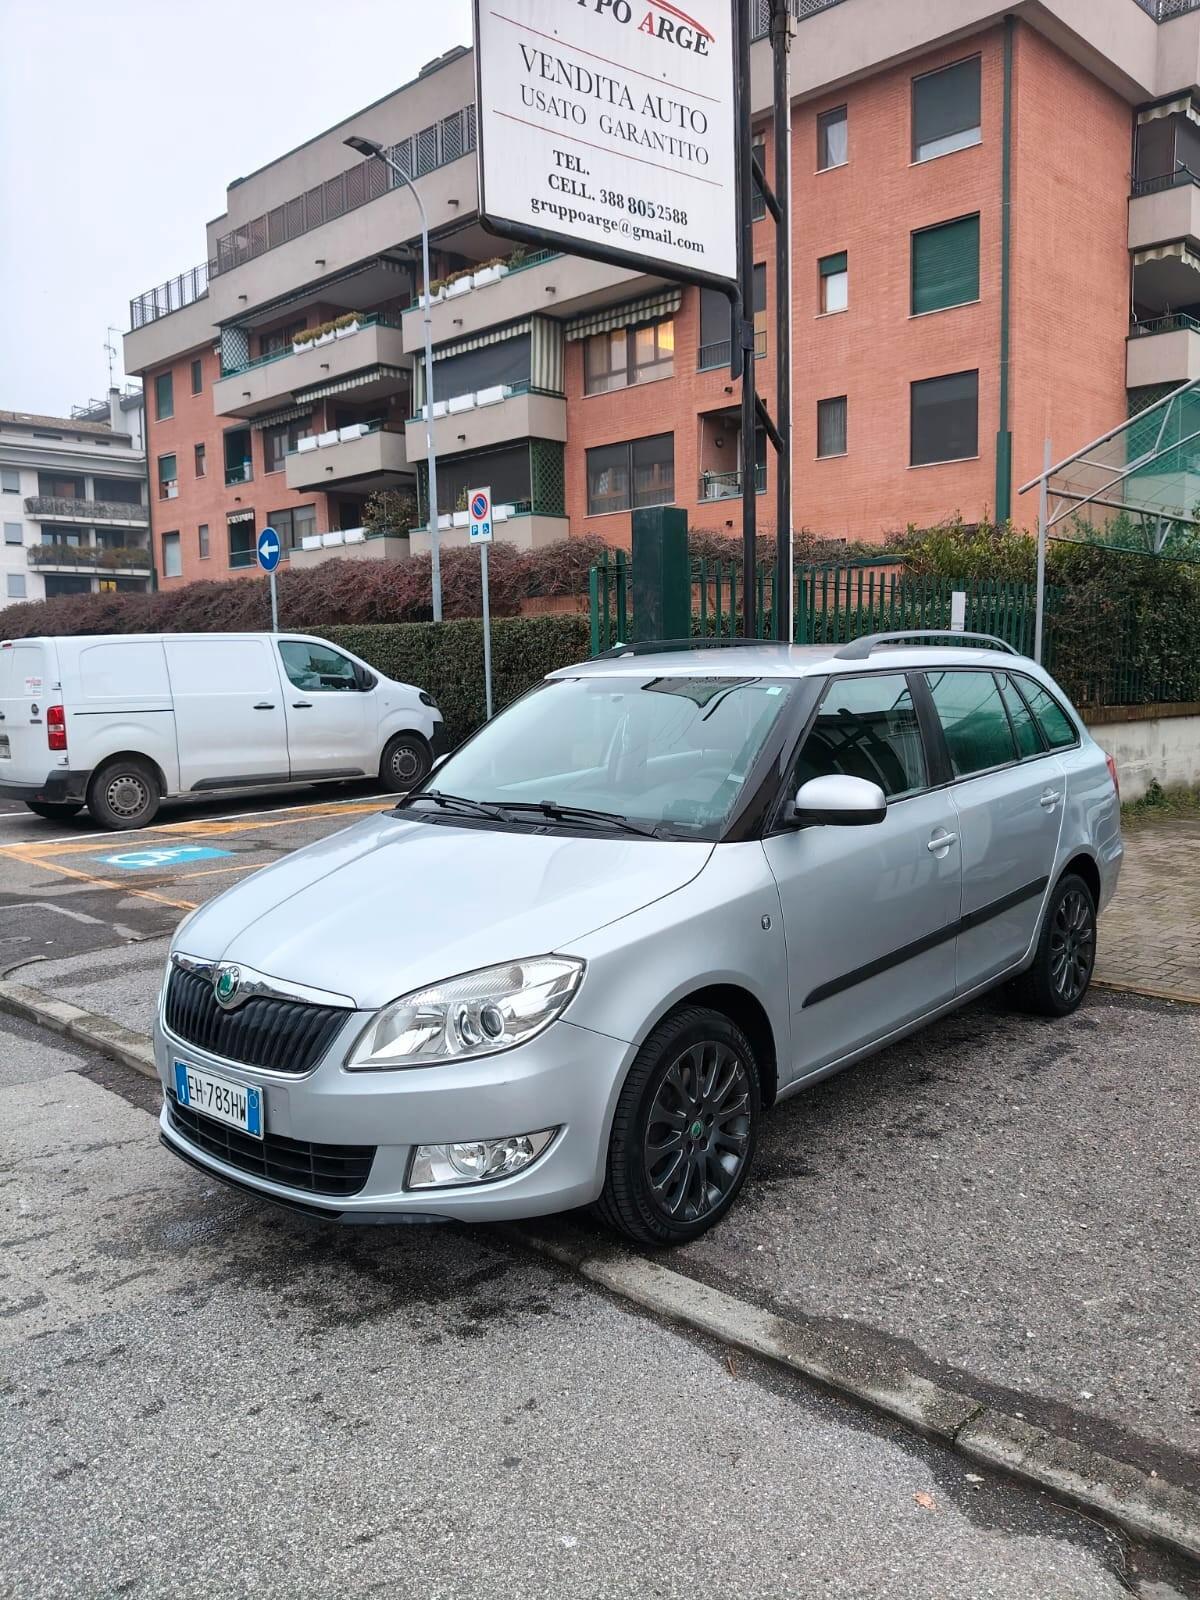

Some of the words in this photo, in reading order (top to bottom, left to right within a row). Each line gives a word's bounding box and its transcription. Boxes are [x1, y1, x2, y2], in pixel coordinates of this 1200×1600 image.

[637, 11, 709, 56] ARGE
[518, 43, 636, 111] VENDITA
[641, 93, 708, 135] AUTO
[520, 84, 587, 125] USATO
[599, 114, 709, 165] GARANTITO
[553, 150, 590, 175] TEL.
[548, 173, 596, 201] CELL.
[600, 189, 625, 209] 388
[531, 198, 705, 253] gruppoarge@gmail.com
